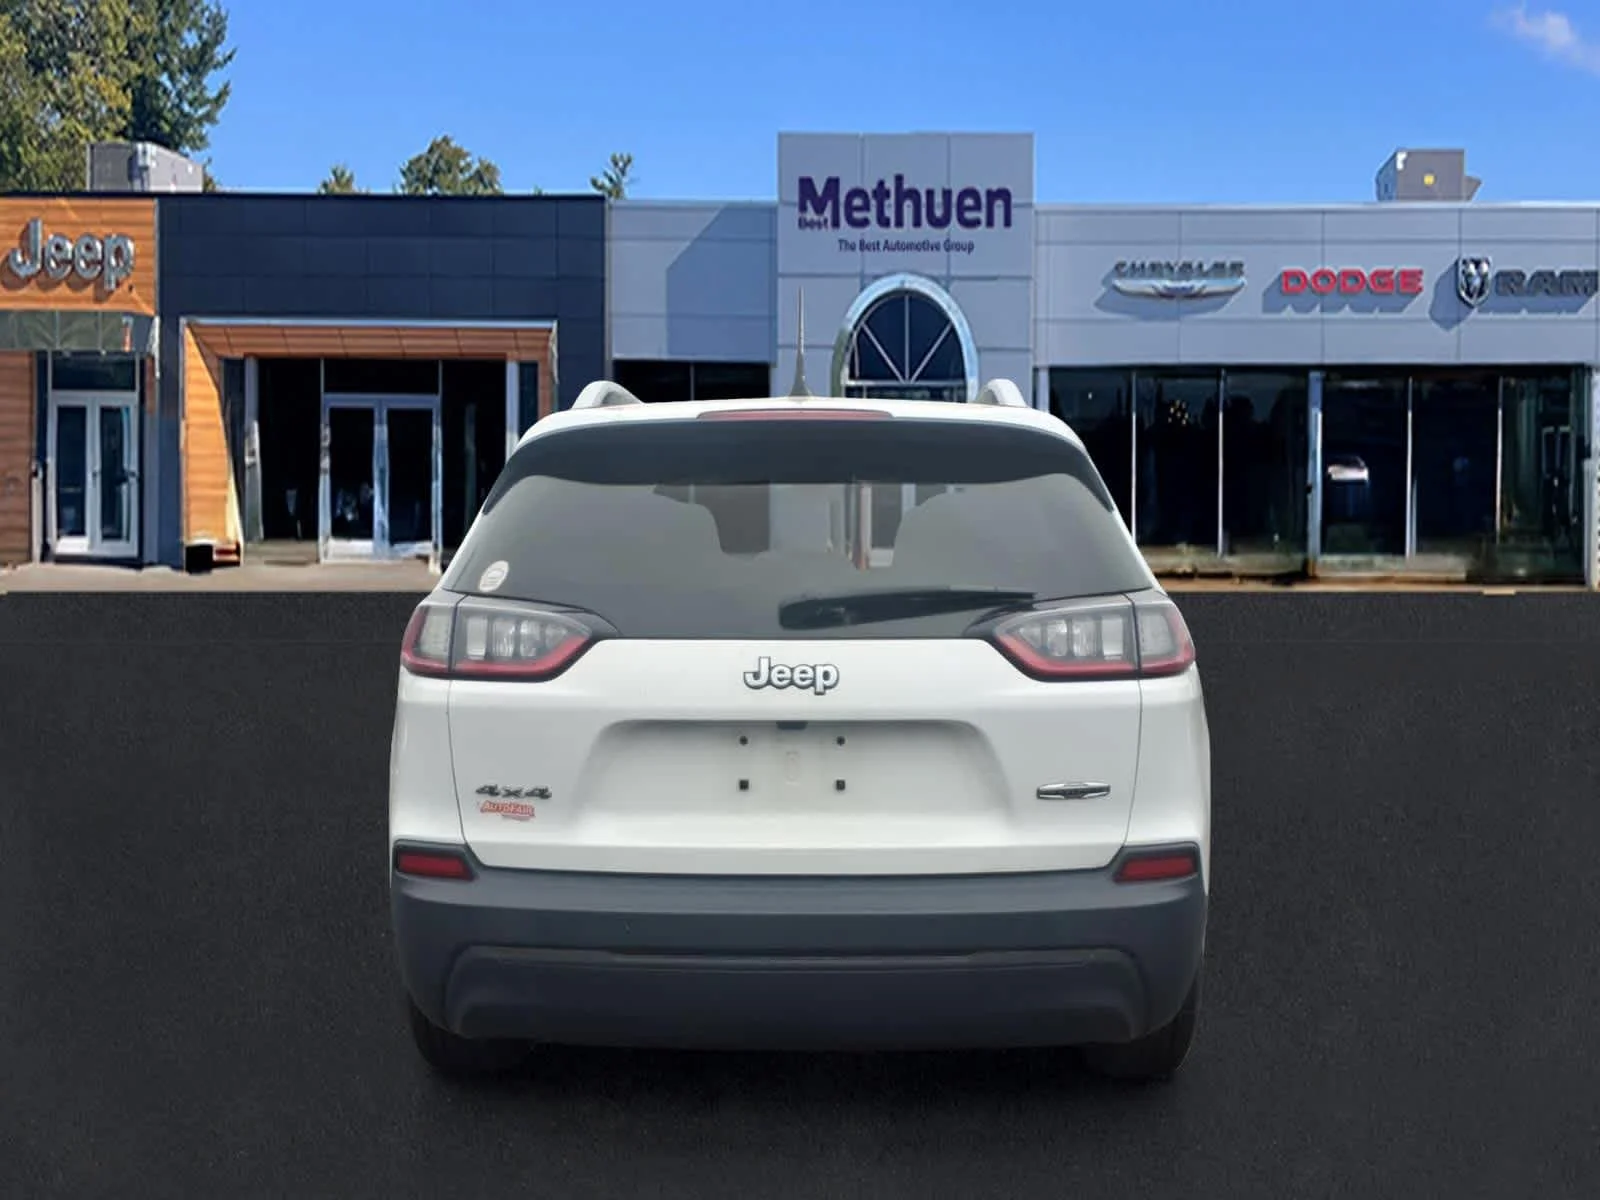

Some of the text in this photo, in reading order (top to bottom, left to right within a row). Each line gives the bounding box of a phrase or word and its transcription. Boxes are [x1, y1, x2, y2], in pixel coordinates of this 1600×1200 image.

[798, 174, 1012, 229] Methuen
[8, 217, 135, 291] Jeep
[838, 239, 975, 255] The Best Automotive Group
[1113, 260, 1244, 280] CHRYSLER
[1281, 268, 1423, 295] DODGE
[1495, 269, 1599, 297] RAM
[743, 656, 840, 696] Jeep
